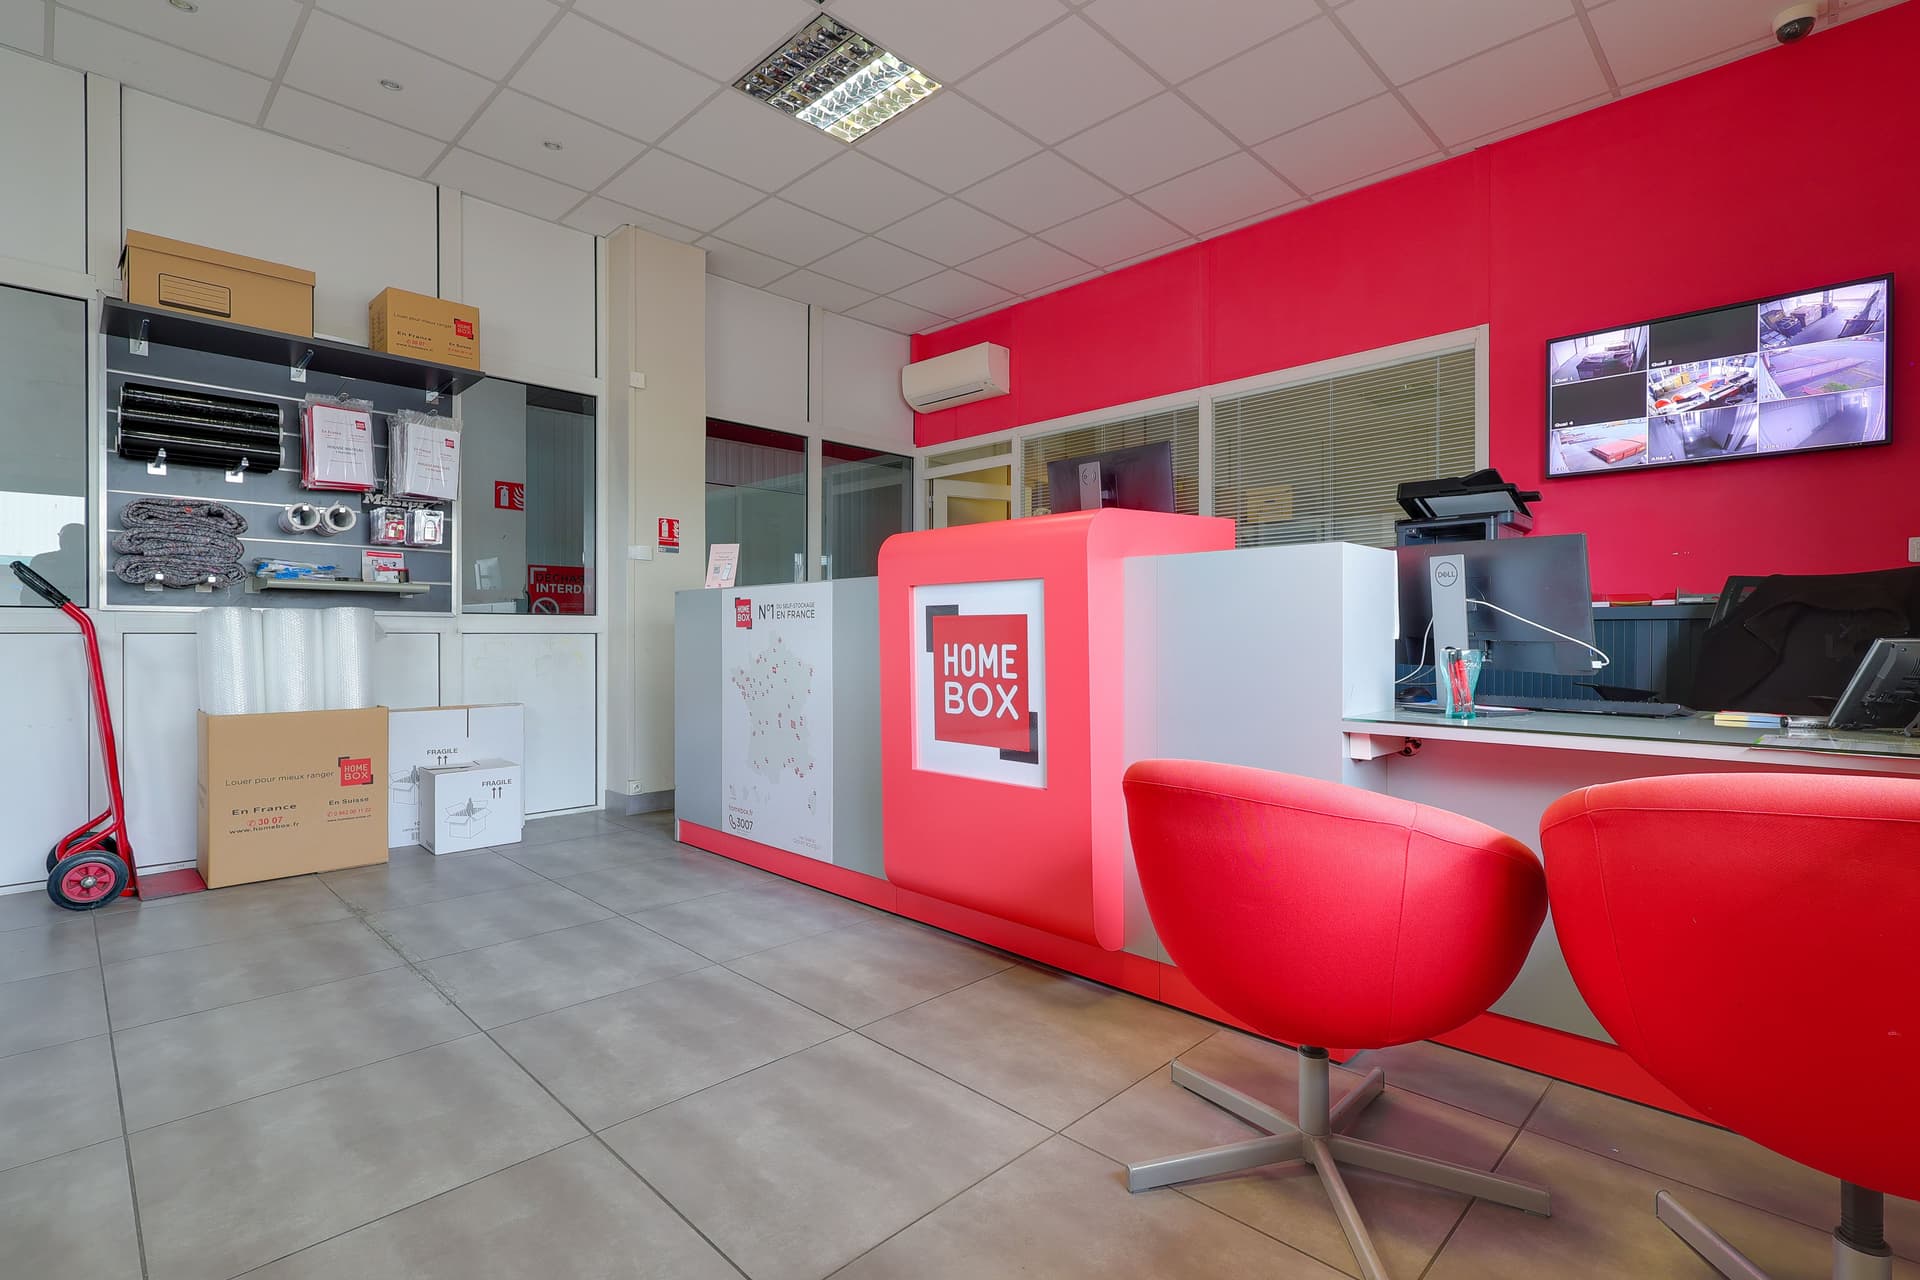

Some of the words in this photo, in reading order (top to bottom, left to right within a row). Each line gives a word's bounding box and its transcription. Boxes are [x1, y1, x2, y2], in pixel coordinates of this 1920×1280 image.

[737, 613, 751, 622] BOX
[776, 611, 786, 620] EN
[787, 609, 815, 619] FRANCE
[943, 643, 1018, 680] HOME
[944, 681, 1019, 720] BOX
[426, 748, 458, 756] FRAGILE
[344, 763, 368, 773] HOME
[225, 778, 252, 787] Louer
[254, 776, 276, 785] pour
[278, 774, 304, 782] mieux
[306, 771, 335, 780] ranger
[344, 771, 368, 781] BOX
[481, 779, 512, 788] FRAGILE
[342, 797, 369, 805] Suisse
[232, 808, 249, 816] En
[253, 804, 297, 813] France
[258, 817, 269, 826] 30
[271, 816, 283, 825] 07
[736, 817, 753, 831] 3007
